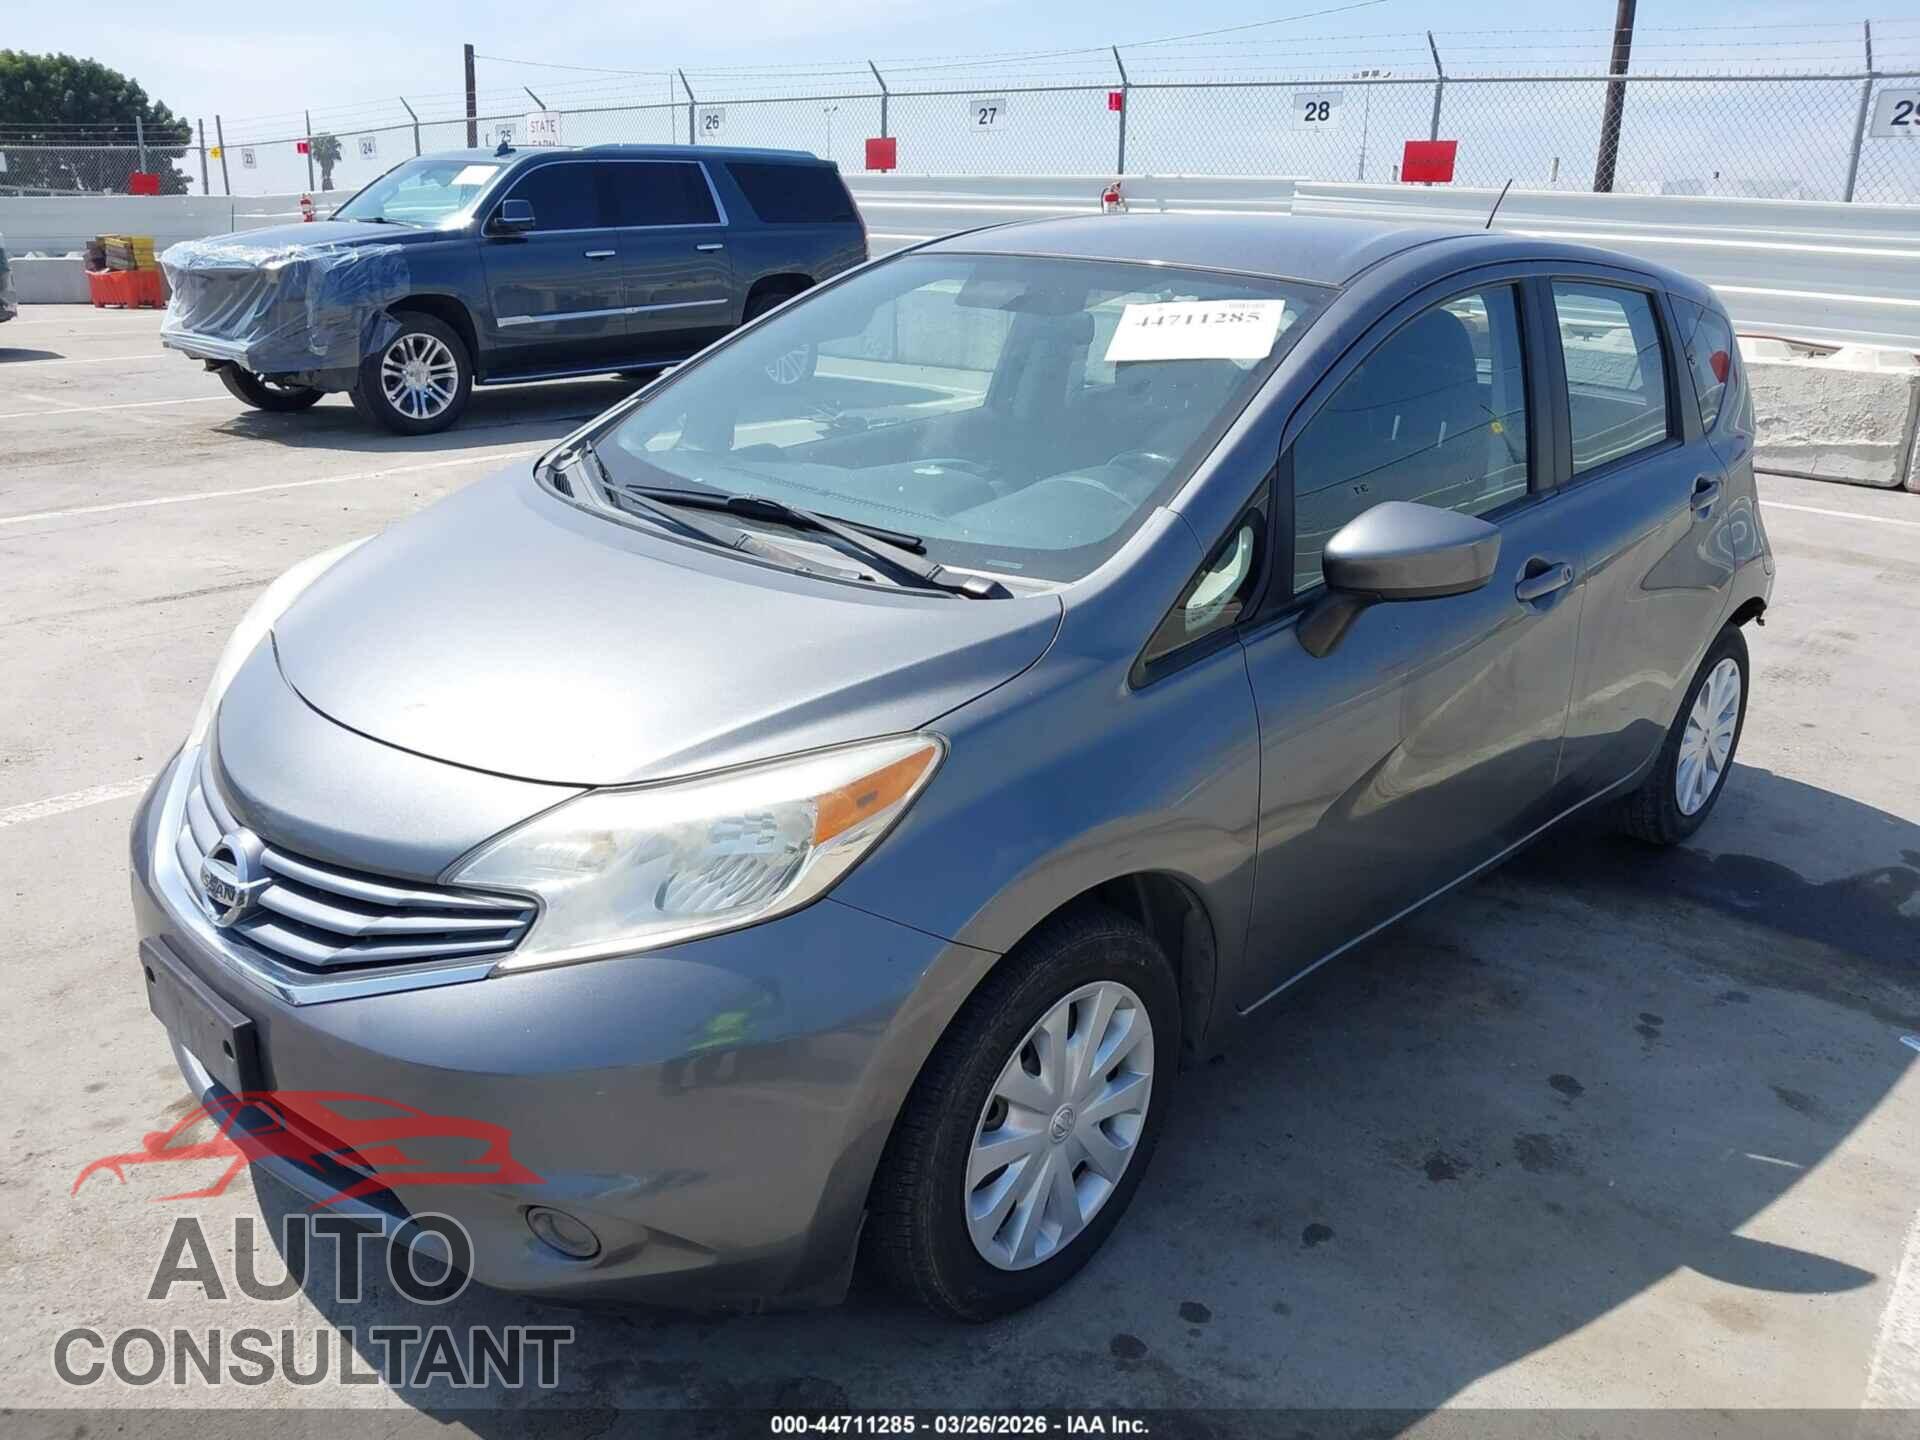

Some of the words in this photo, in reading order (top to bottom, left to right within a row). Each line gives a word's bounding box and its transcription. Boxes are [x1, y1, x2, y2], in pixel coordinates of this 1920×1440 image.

[979, 107, 997, 125] 27
[1304, 101, 1330, 122] 28
[1891, 100, 1920, 126] 2
[531, 119, 556, 133] STATE
[705, 114, 720, 130] 26
[500, 129, 512, 143] 25
[1136, 311, 1262, 328] 44711285
